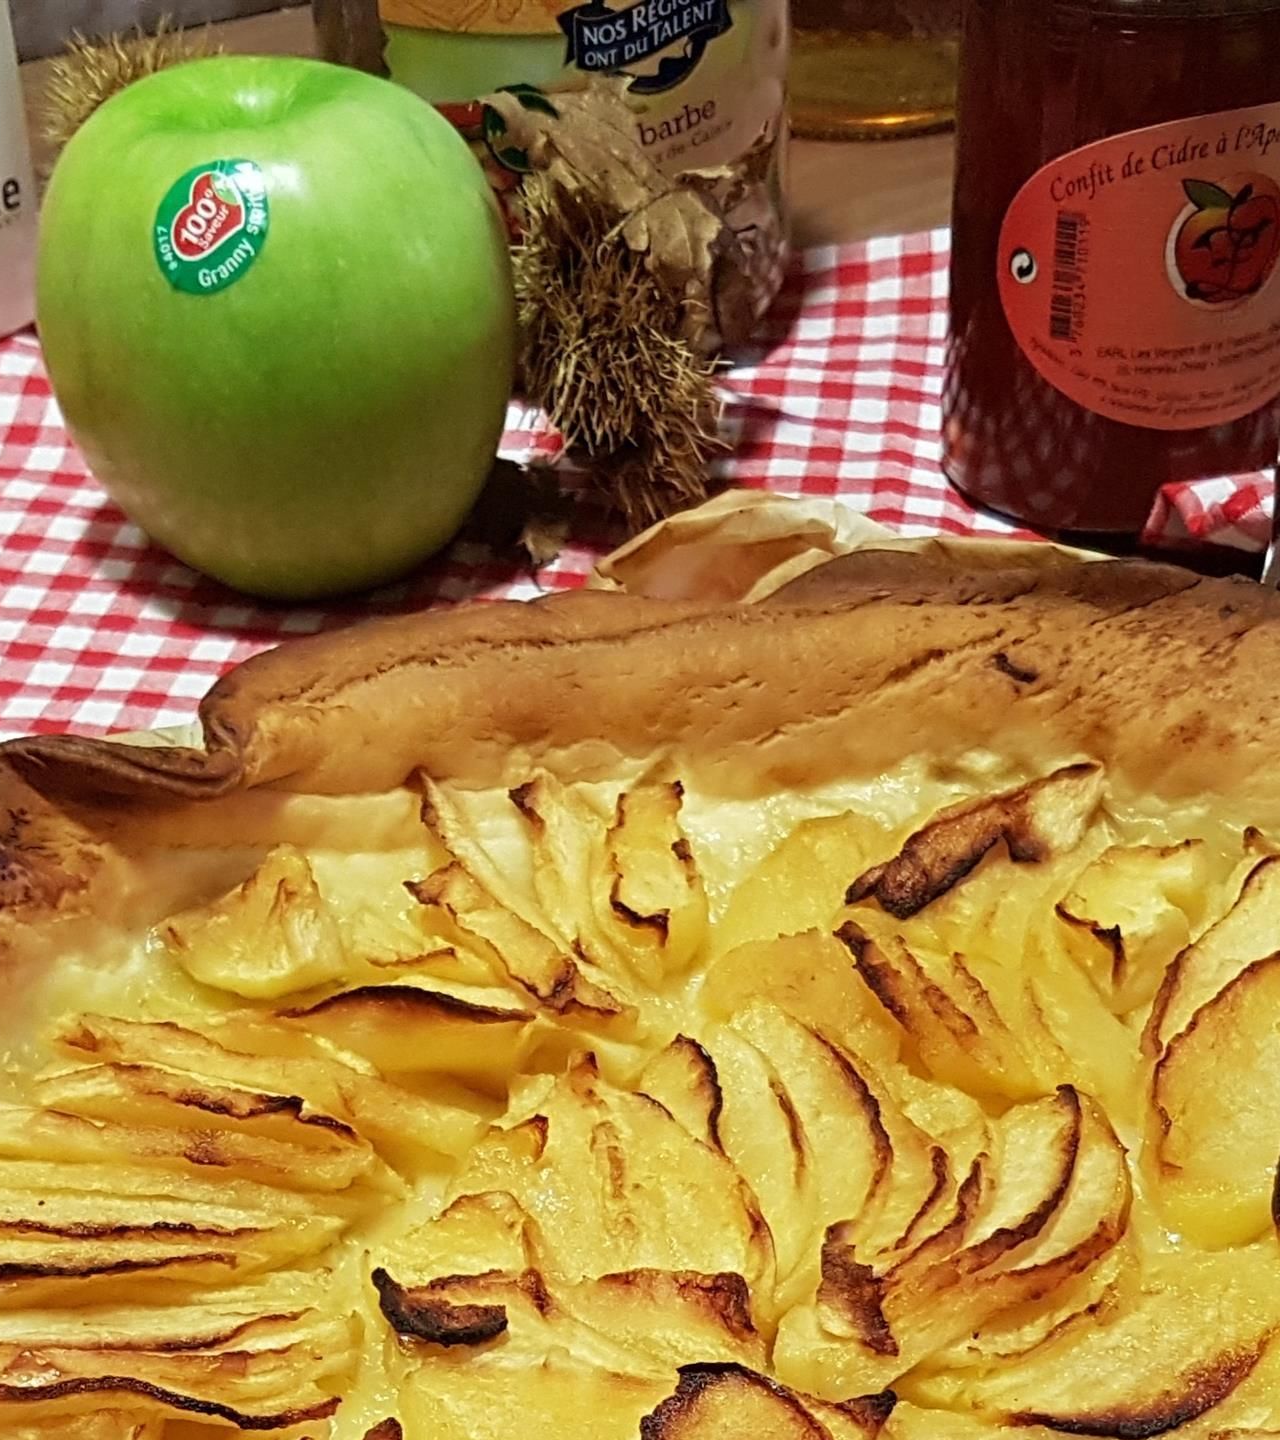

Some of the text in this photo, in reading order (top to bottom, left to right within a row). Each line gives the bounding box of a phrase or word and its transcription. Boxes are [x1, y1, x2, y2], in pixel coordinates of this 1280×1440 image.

[583, 19, 627, 47] NOS
[584, 0, 715, 67] ONT DU TALENT
[1049, 163, 1115, 202] Confit
[1122, 151, 1144, 179] de
[1151, 136, 1210, 171] Cidre
[1215, 131, 1228, 155] à
[197, 204, 230, 250] Saveur
[197, 237, 256, 288] Granny
